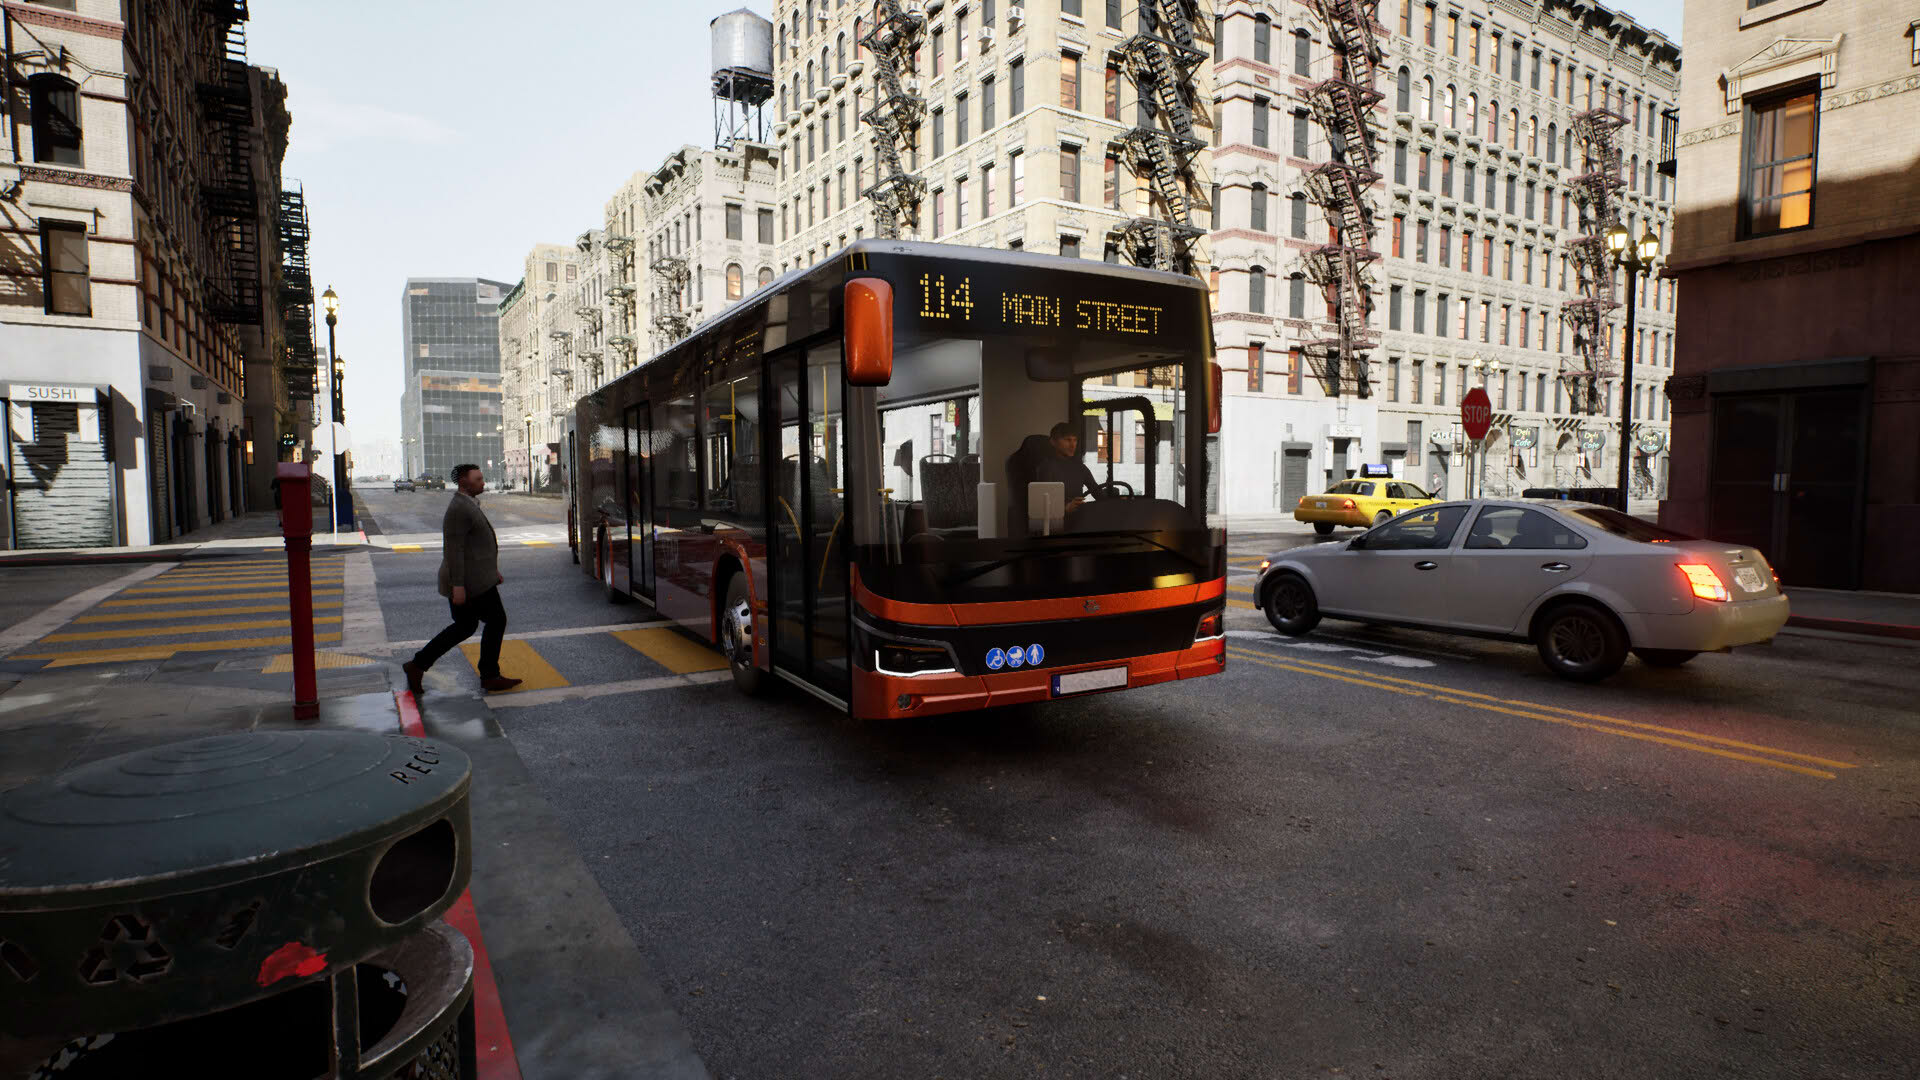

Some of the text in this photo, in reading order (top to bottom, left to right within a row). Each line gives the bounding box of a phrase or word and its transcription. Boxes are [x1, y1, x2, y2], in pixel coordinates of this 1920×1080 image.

[919, 273, 1163, 334] 114 MAIN STREET
[27, 387, 77, 399] SUSHI
[1464, 405, 1489, 424] STOP
